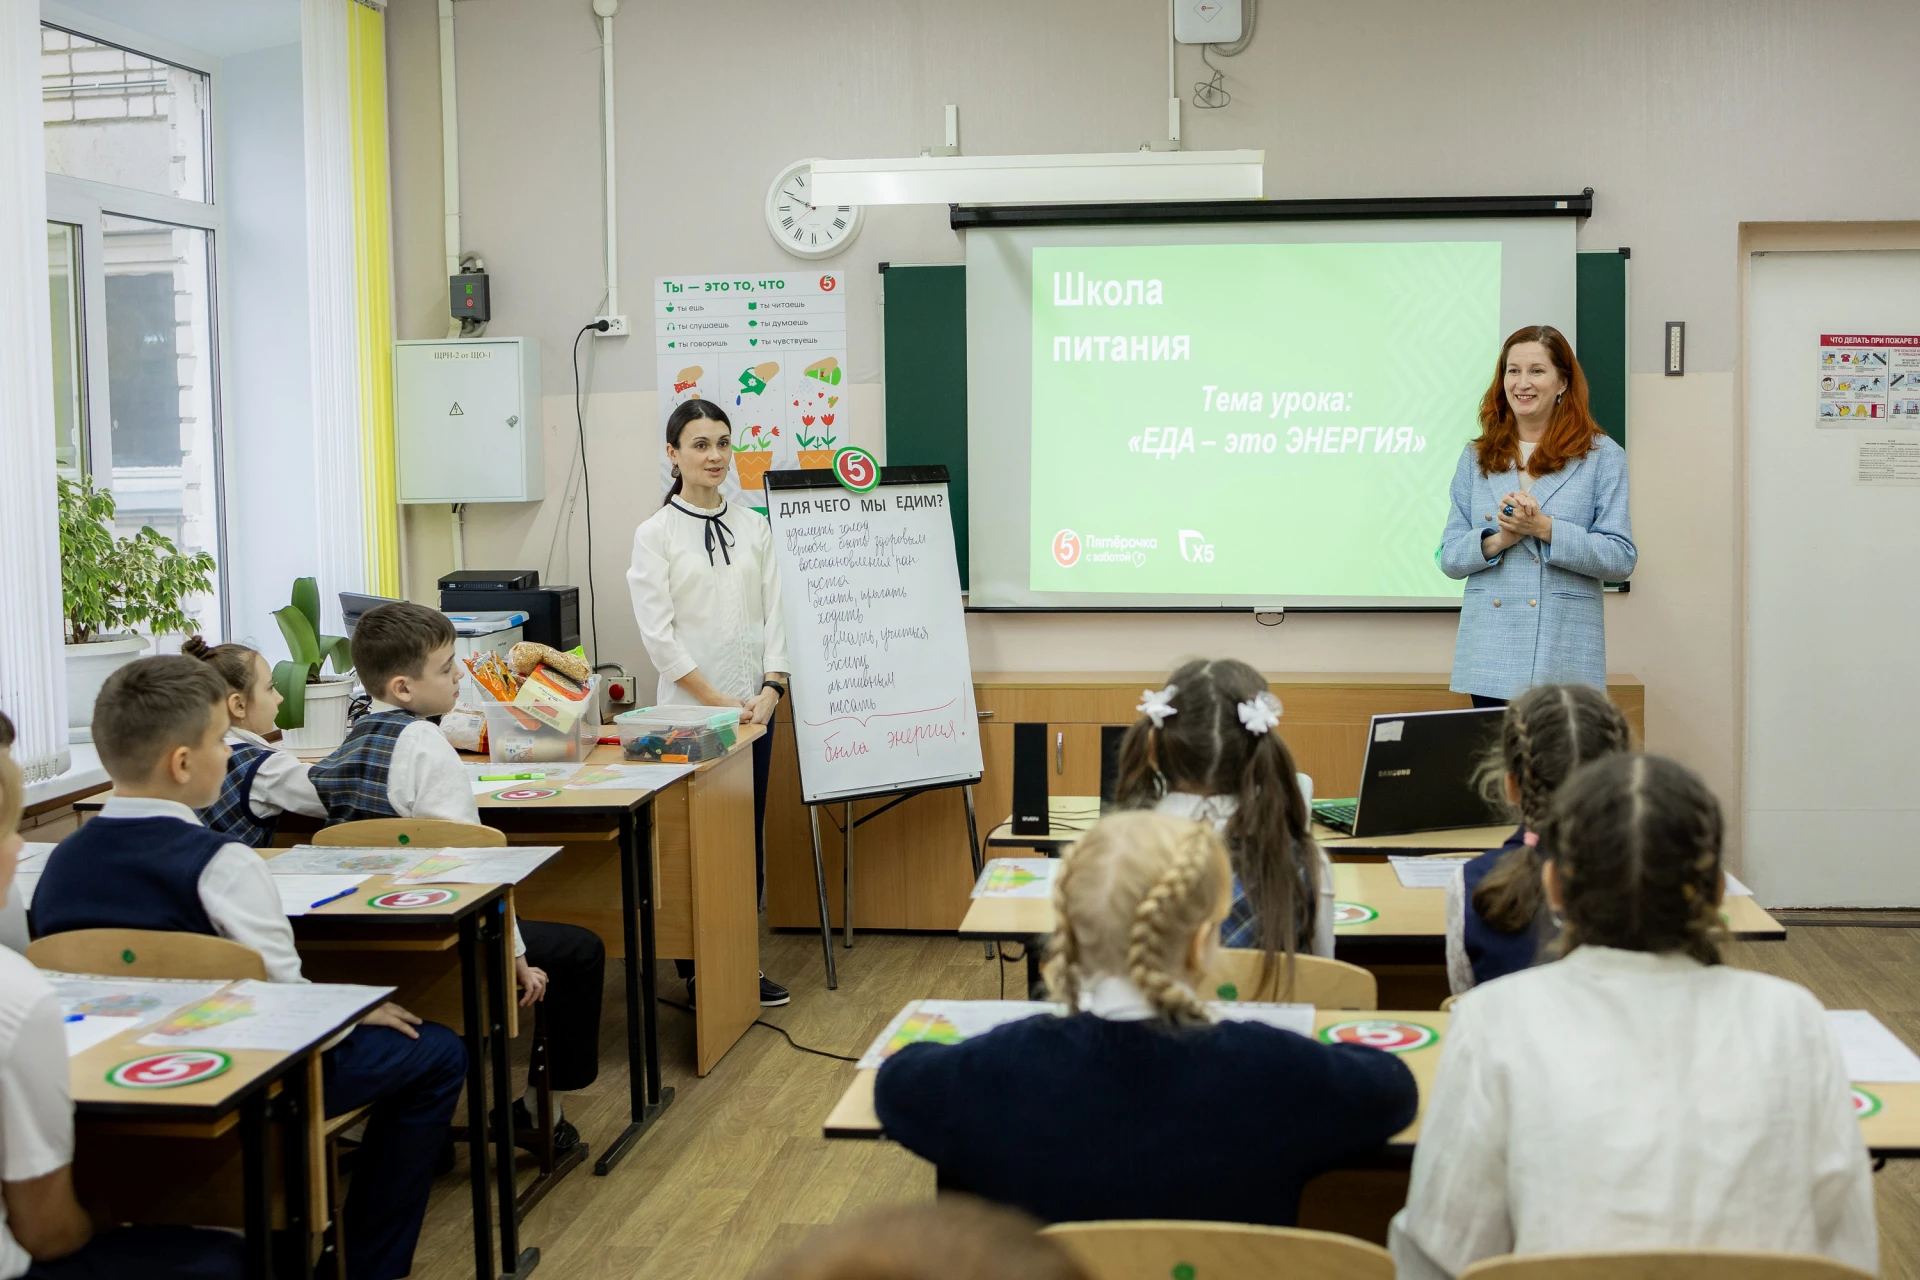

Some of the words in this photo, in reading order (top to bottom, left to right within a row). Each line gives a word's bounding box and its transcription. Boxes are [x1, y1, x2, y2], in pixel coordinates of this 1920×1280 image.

[663, 281, 683, 293] Ты
[704, 281, 730, 292] это
[733, 280, 754, 293] то,
[758, 279, 785, 290] что
[1053, 271, 1163, 306] Школа
[677, 304, 687, 312] ты
[688, 304, 704, 312] ешь
[760, 301, 770, 309] ты
[772, 301, 805, 309] читаешь
[677, 322, 688, 330] ты
[689, 321, 729, 331] слушаешь
[760, 319, 771, 327] ты
[772, 319, 808, 328] думаешь
[678, 340, 688, 348] ты
[690, 340, 728, 349] говоришь
[761, 337, 771, 345] ты
[773, 337, 818, 347] чувствуешь
[1053, 334, 1191, 362] питания
[1830, 336, 1843, 344] ЧТО
[1844, 336, 1870, 345] ДЕЛАТЬ
[434, 351, 459, 360] ЩРН-2
[470, 351, 491, 360] ЩО-1
[1202, 385, 1263, 412] Тема
[1269, 390, 1354, 419] урока:
[1127, 426, 1195, 460] «ЕДА
[1224, 432, 1277, 453] это
[1286, 426, 1427, 454] ЭНЕРГИЯ»
[847, 454, 866, 481] 5
[780, 500, 810, 518] ДЛЯ
[814, 498, 850, 514] ЧЕГО
[861, 499, 886, 512] МЫ
[896, 494, 943, 511] ЕДИМ?
[875, 527, 926, 557] здоровым
[1085, 535, 1158, 552] Пятёрочка
[896, 554, 920, 574] ран
[1086, 553, 1091, 562] с
[1093, 551, 1131, 562] заботой
[818, 608, 863, 634] ходить
[823, 630, 878, 660] думать,
[881, 626, 929, 652] учиться
[826, 654, 869, 679] жить
[828, 671, 895, 694] активным
[830, 699, 876, 715] писать
[824, 731, 869, 762] была
